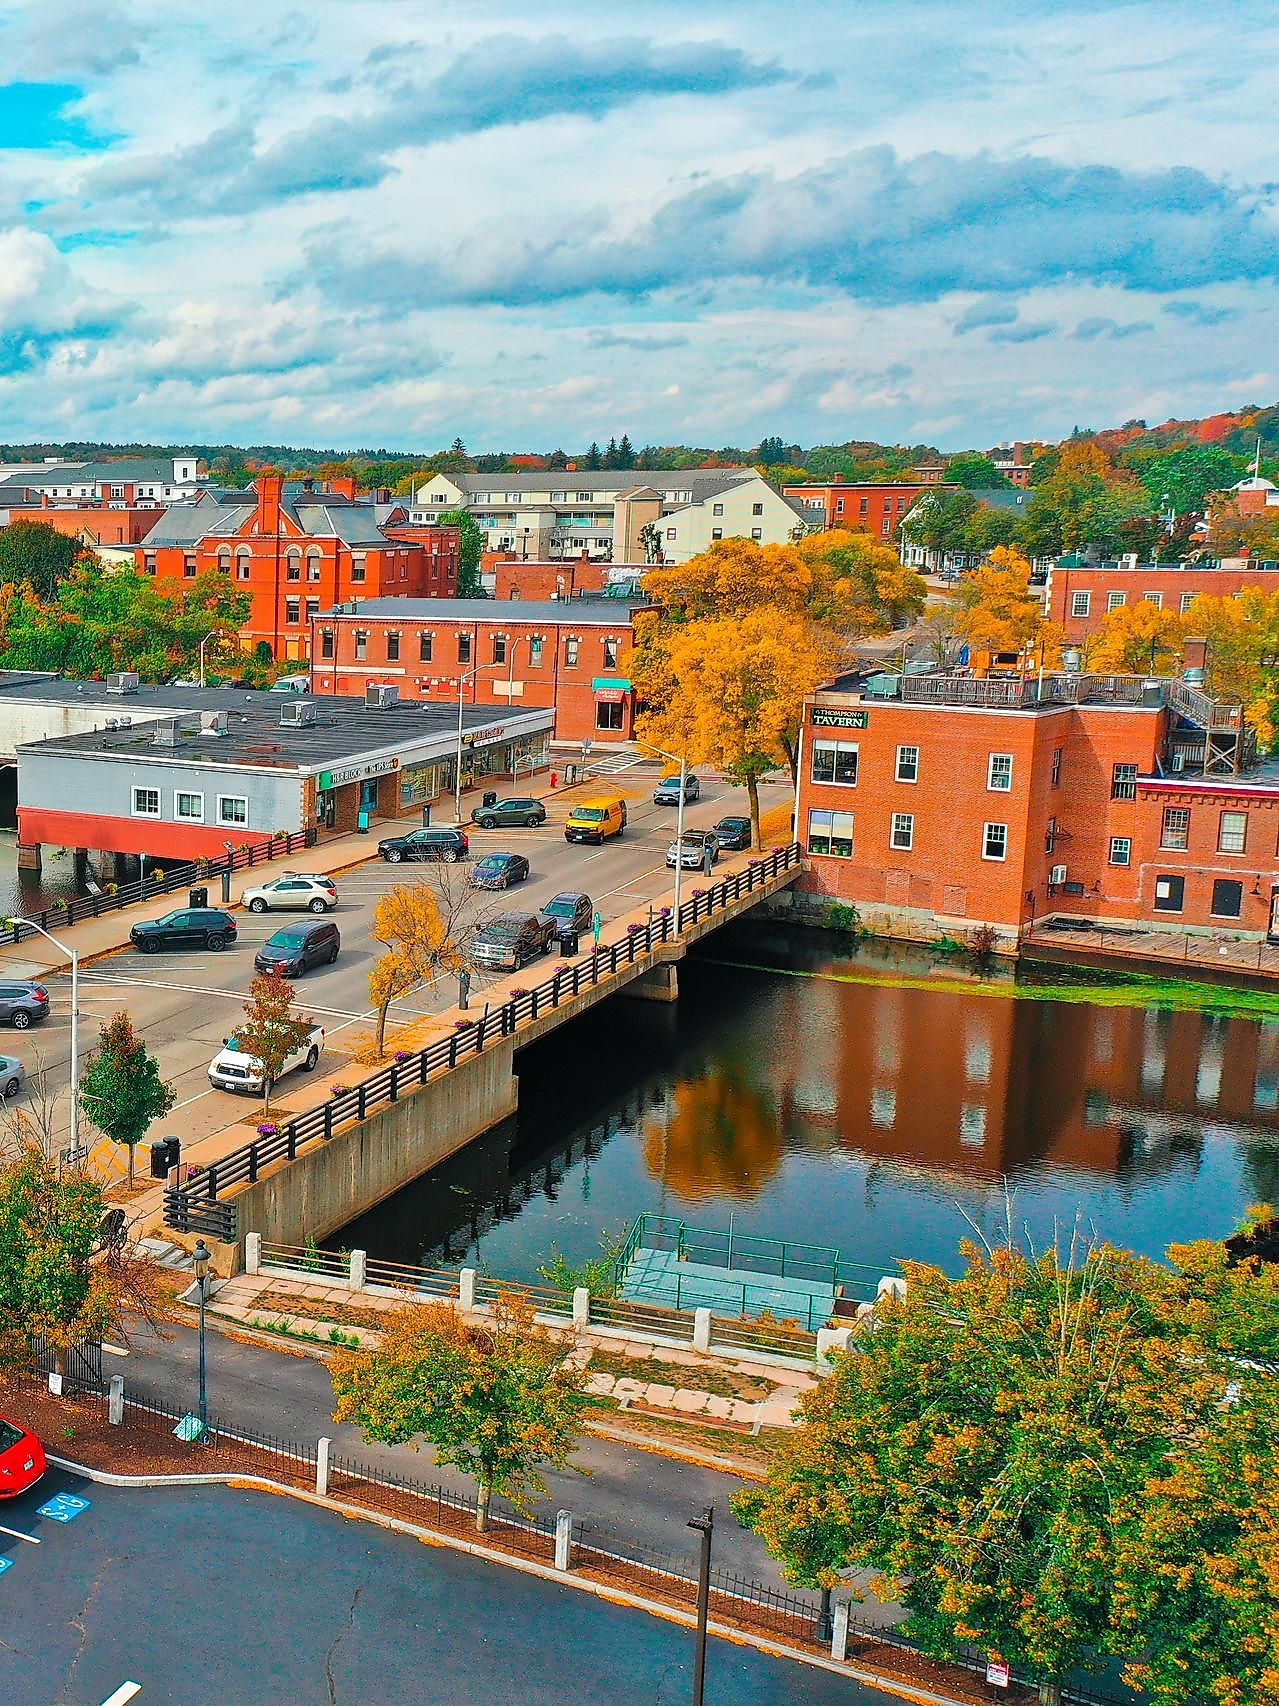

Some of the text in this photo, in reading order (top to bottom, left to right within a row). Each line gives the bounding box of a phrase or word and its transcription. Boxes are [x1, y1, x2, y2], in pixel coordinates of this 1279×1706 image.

[820, 709, 857, 718] THOMPSON
[813, 715, 863, 728] TAVERN
[344, 767, 362, 780] BLOCK
[41, 1495, 85, 1521] S+G
